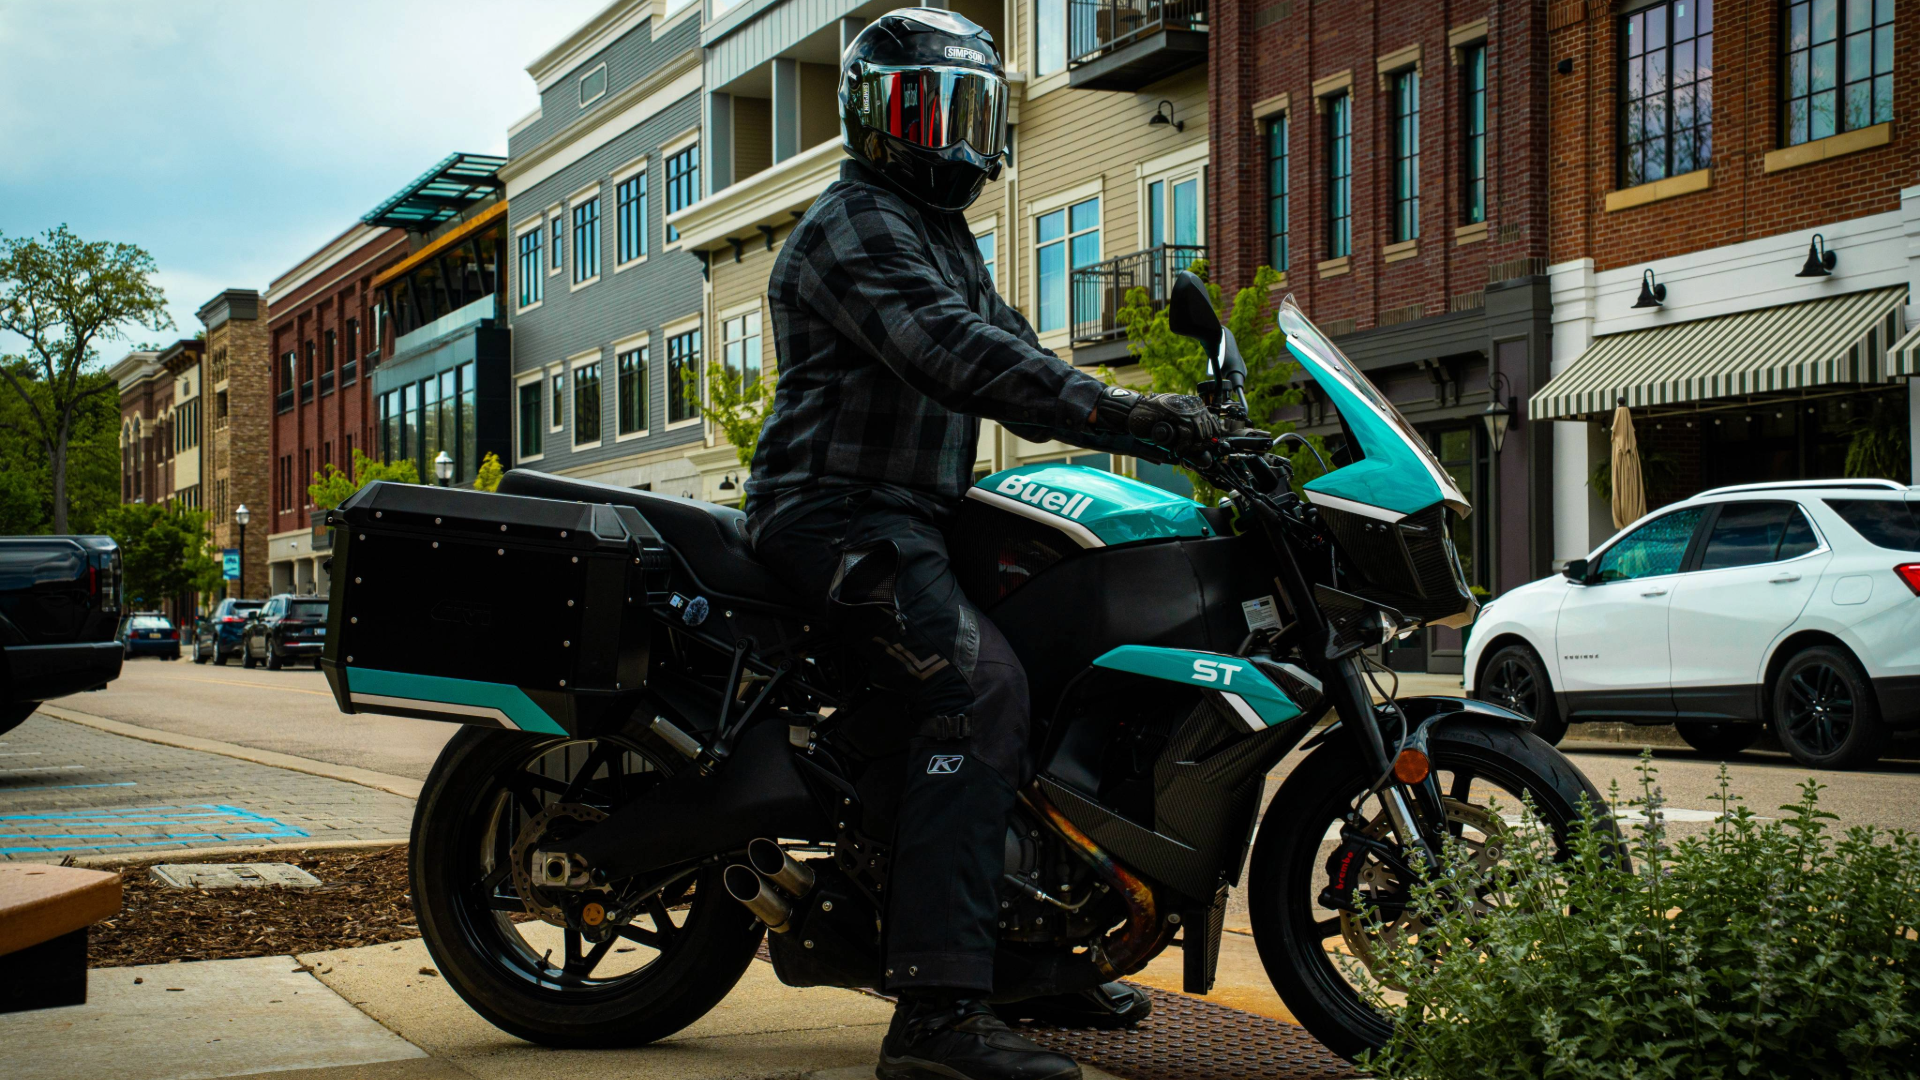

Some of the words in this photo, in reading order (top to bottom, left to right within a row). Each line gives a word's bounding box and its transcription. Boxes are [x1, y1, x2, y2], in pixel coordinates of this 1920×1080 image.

[947, 47, 983, 62] SIMPSON
[996, 475, 1094, 519] Buell
[1191, 659, 1243, 686] ST
[928, 757, 962, 772] K
[1335, 851, 1354, 890] brembo
